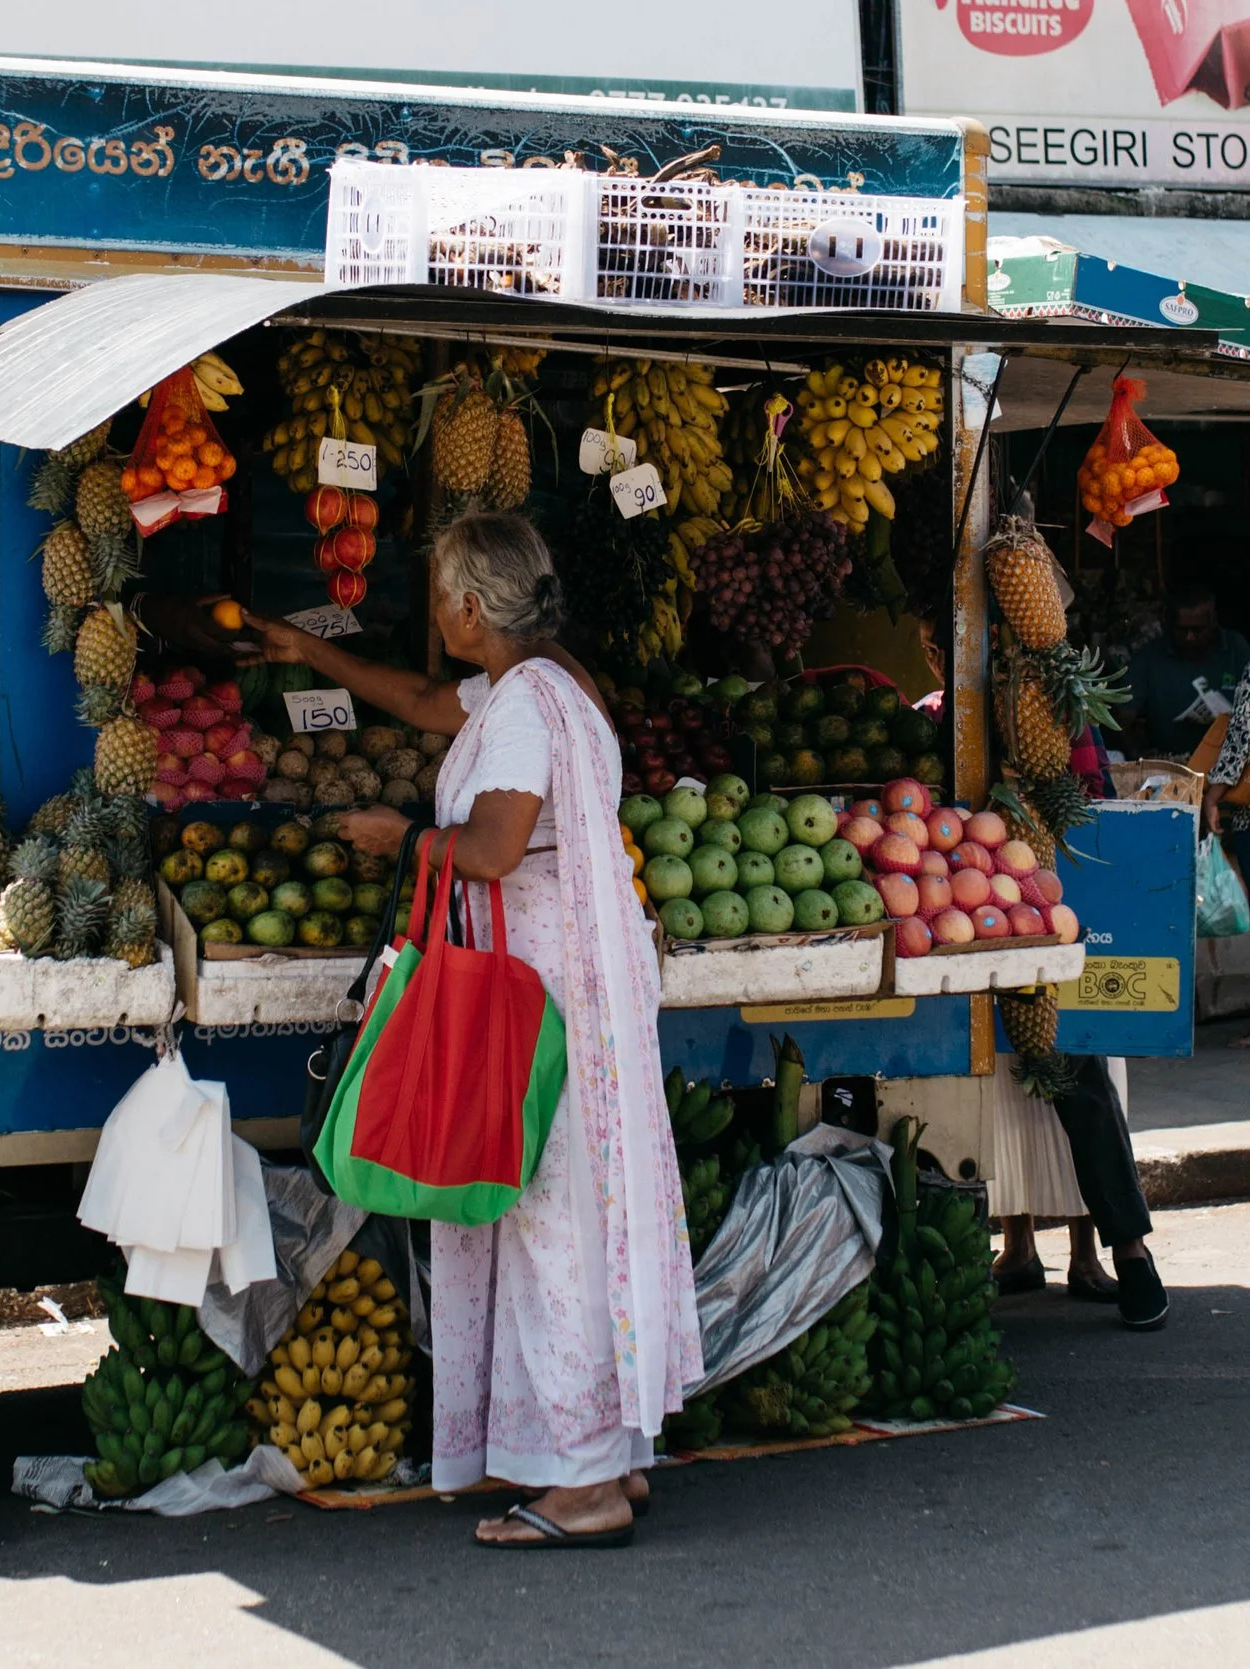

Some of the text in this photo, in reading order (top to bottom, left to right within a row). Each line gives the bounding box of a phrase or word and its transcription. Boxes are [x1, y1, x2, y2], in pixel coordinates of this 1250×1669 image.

[970, 10, 1063, 37] BISCUITS
[988, 125, 1249, 171] SEEGIRI STO
[1078, 971, 1146, 999] BOC
